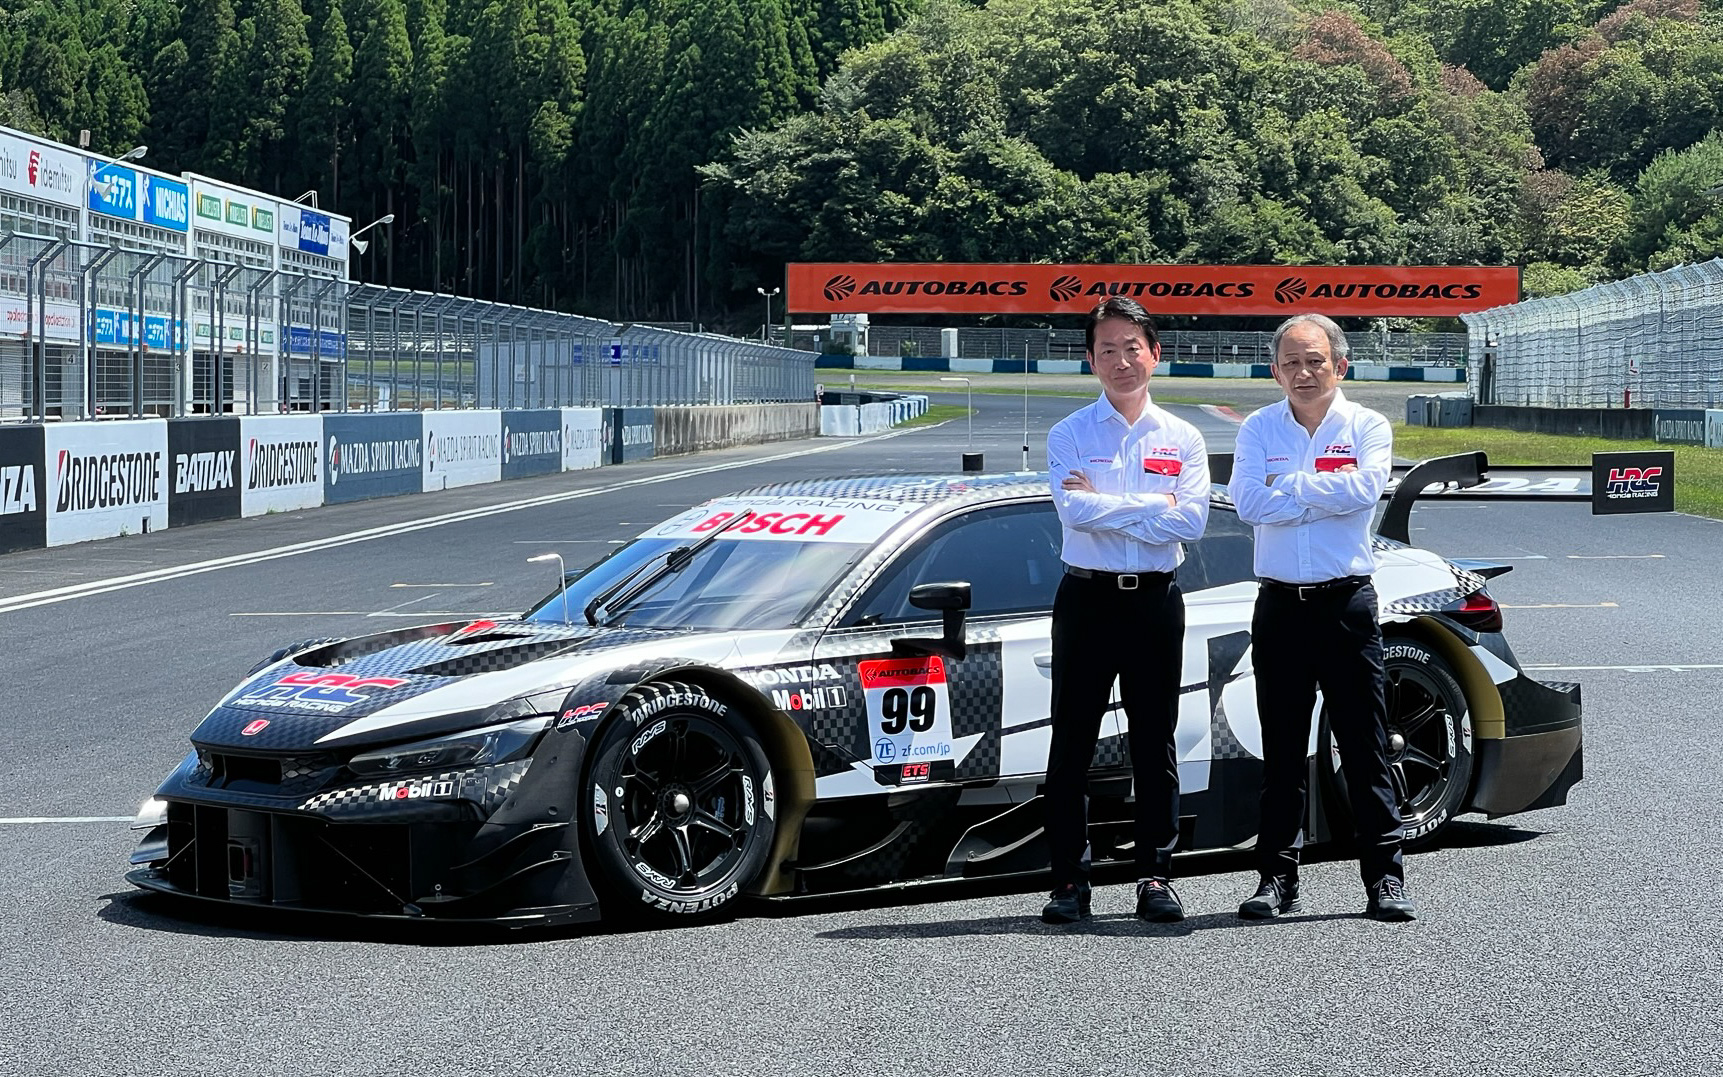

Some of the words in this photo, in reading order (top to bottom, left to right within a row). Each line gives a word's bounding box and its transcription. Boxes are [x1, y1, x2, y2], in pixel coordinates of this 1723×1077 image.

[41, 157, 72, 193] idemitsu
[155, 185, 186, 225] NICHIAS
[858, 281, 1028, 297] AUTOBACS
[1083, 281, 1255, 298] AUTOBACS
[1309, 284, 1482, 299] AUTOBACS
[248, 438, 318, 490] BRIDGESTONE
[340, 443, 370, 475] MAZDA
[371, 441, 393, 473] SPIRIT
[394, 439, 420, 470] RACING
[56, 449, 161, 513] BRIDGESTONE
[1606, 466, 1663, 493] HRC
[786, 499, 901, 513] RACING
[1382, 645, 1431, 664] GESTONE
[877, 666, 941, 678] AUTOBACS
[241, 671, 413, 707] HRC
[771, 687, 826, 711] Mobil
[284, 700, 348, 714] RACING
[558, 701, 610, 726] HRC
[632, 692, 728, 728] BRIDGESTONE
[880, 685, 937, 736] 99
[632, 720, 667, 756] RAYS
[1444, 713, 1457, 759] RAYS
[901, 742, 950, 758] zf.com/jp
[903, 764, 929, 777] ETS
[379, 783, 432, 801] Mobil
[742, 775, 756, 826] RAYS
[635, 861, 676, 889] RAYS
[641, 882, 739, 914] POTENZA
